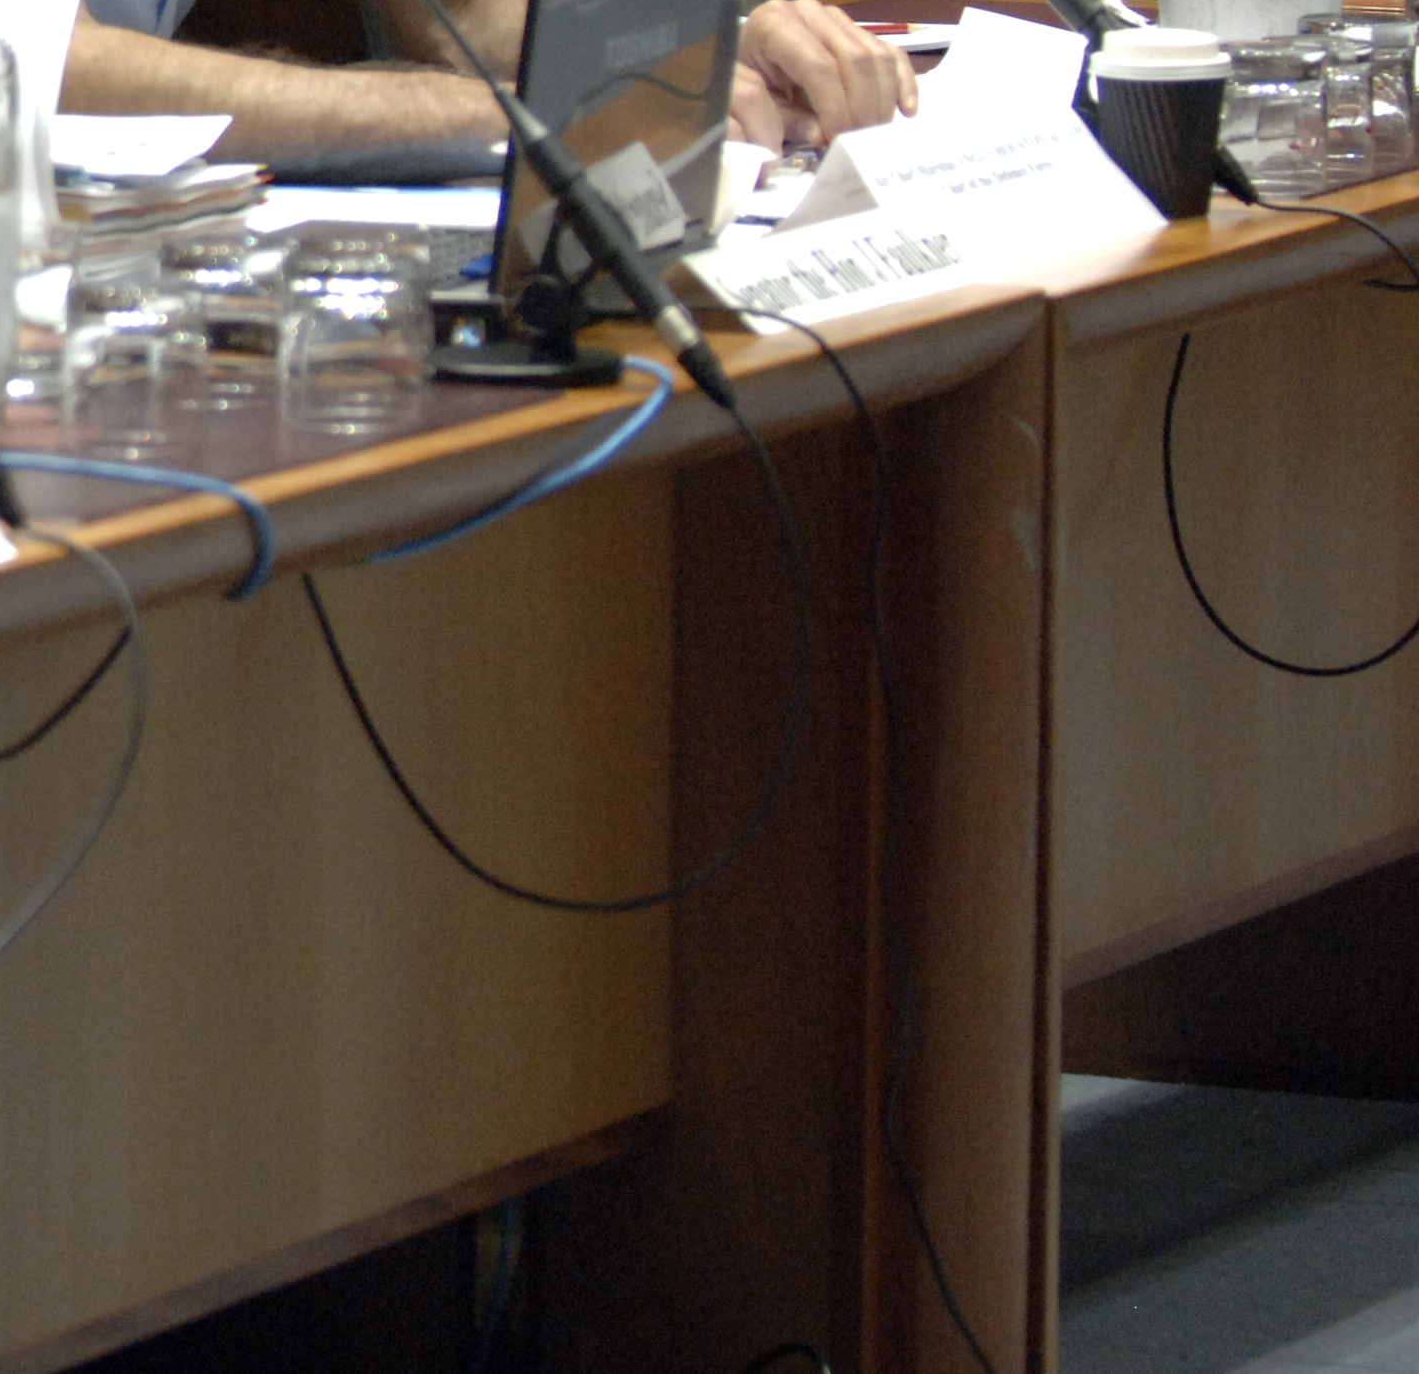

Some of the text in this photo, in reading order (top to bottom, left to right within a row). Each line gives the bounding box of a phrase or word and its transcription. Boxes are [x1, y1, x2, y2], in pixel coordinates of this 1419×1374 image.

[810, 248, 877, 294] Hon
[863, 229, 963, 280] Faulkner
[786, 258, 839, 301] the
